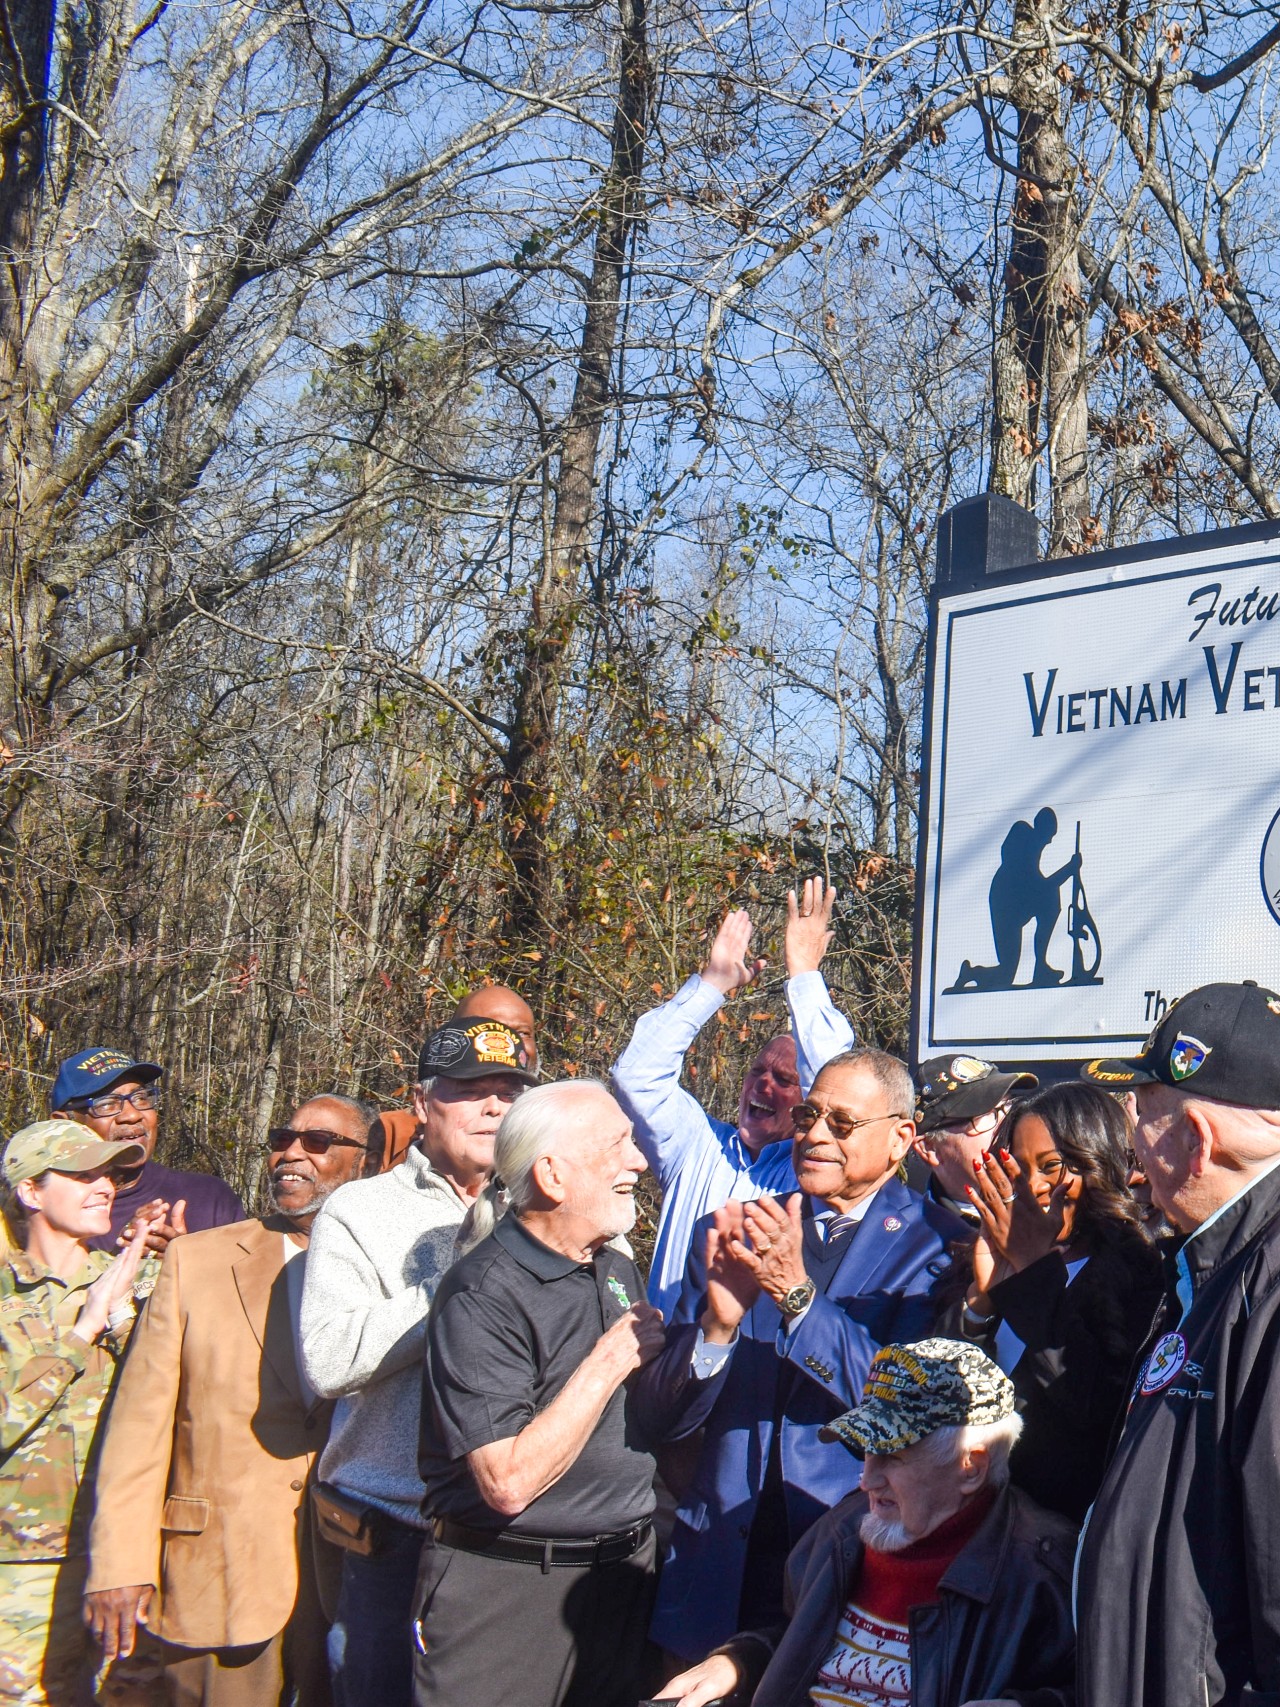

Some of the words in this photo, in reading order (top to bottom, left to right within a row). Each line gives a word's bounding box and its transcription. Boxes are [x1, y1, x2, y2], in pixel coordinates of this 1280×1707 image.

[1023, 668, 1188, 737] VIETNAM
[464, 1022, 520, 1045] VIETNAM
[478, 1054, 517, 1067] VETERAN
[1093, 1071, 1134, 1080] VETERAN
[133, 1281, 155, 1295] ORCE
